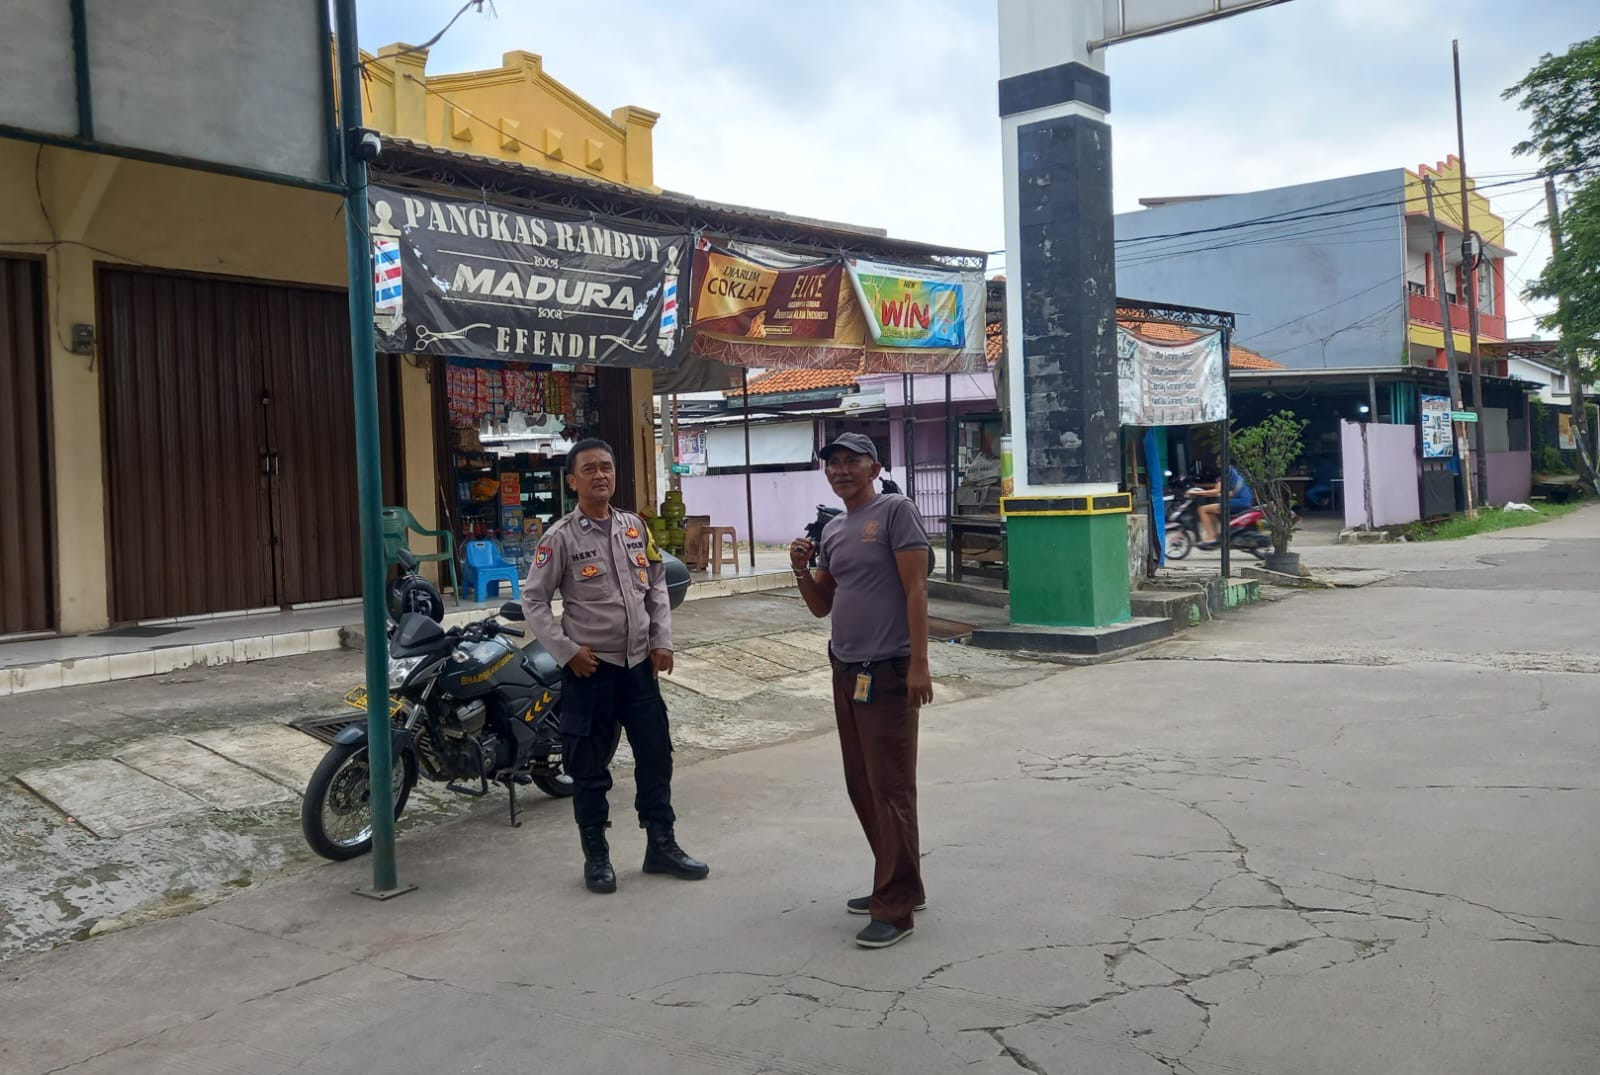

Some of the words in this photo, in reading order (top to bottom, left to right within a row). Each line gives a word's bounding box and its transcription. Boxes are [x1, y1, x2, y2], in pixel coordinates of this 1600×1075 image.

[402, 197, 549, 248] PANGKAS
[553, 221, 661, 264] RAMBUT
[451, 264, 634, 311] MADURA
[723, 266, 760, 282] DJARUM
[791, 274, 826, 298] ELITE
[903, 280, 917, 289] NEW
[707, 277, 768, 303] COKLAT
[881, 291, 930, 329] WIN
[496, 326, 597, 359] EFENDI
